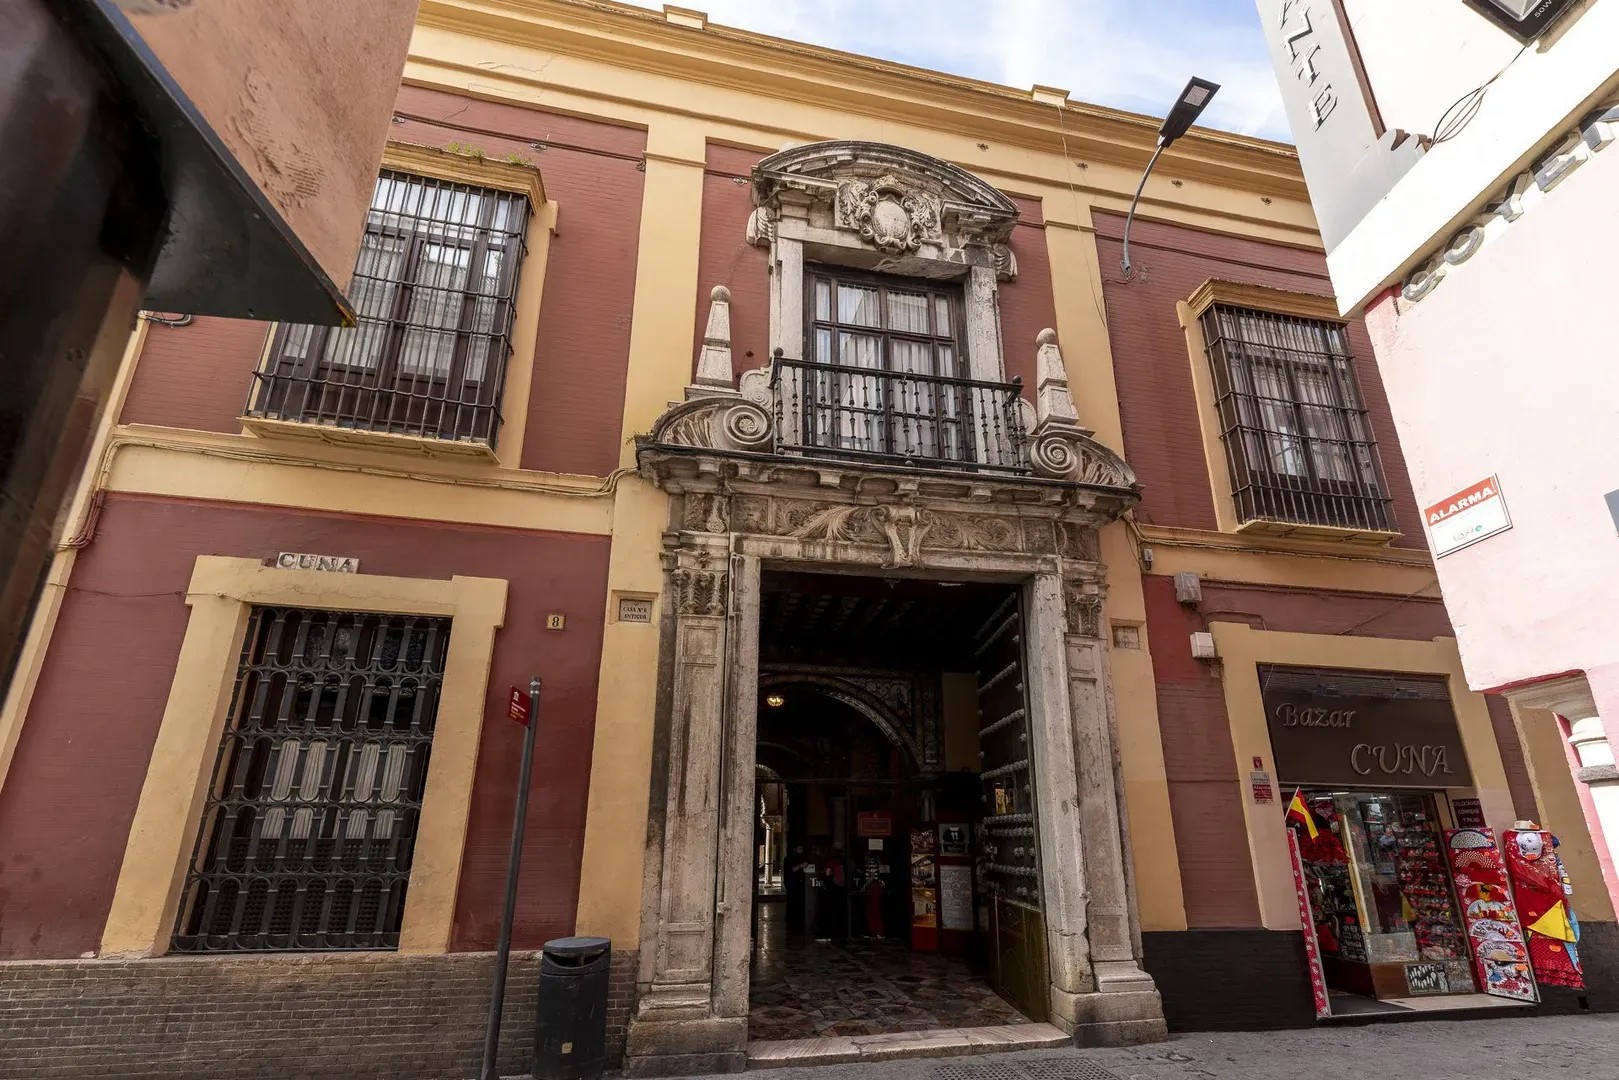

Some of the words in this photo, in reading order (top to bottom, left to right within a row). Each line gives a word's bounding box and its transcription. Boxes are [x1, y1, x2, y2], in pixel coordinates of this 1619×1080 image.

[279, 553, 354, 573] CUNA
[551, 615, 560, 628] 8
[1276, 703, 1356, 729] Bazar
[1350, 743, 1454, 777] CUNA
